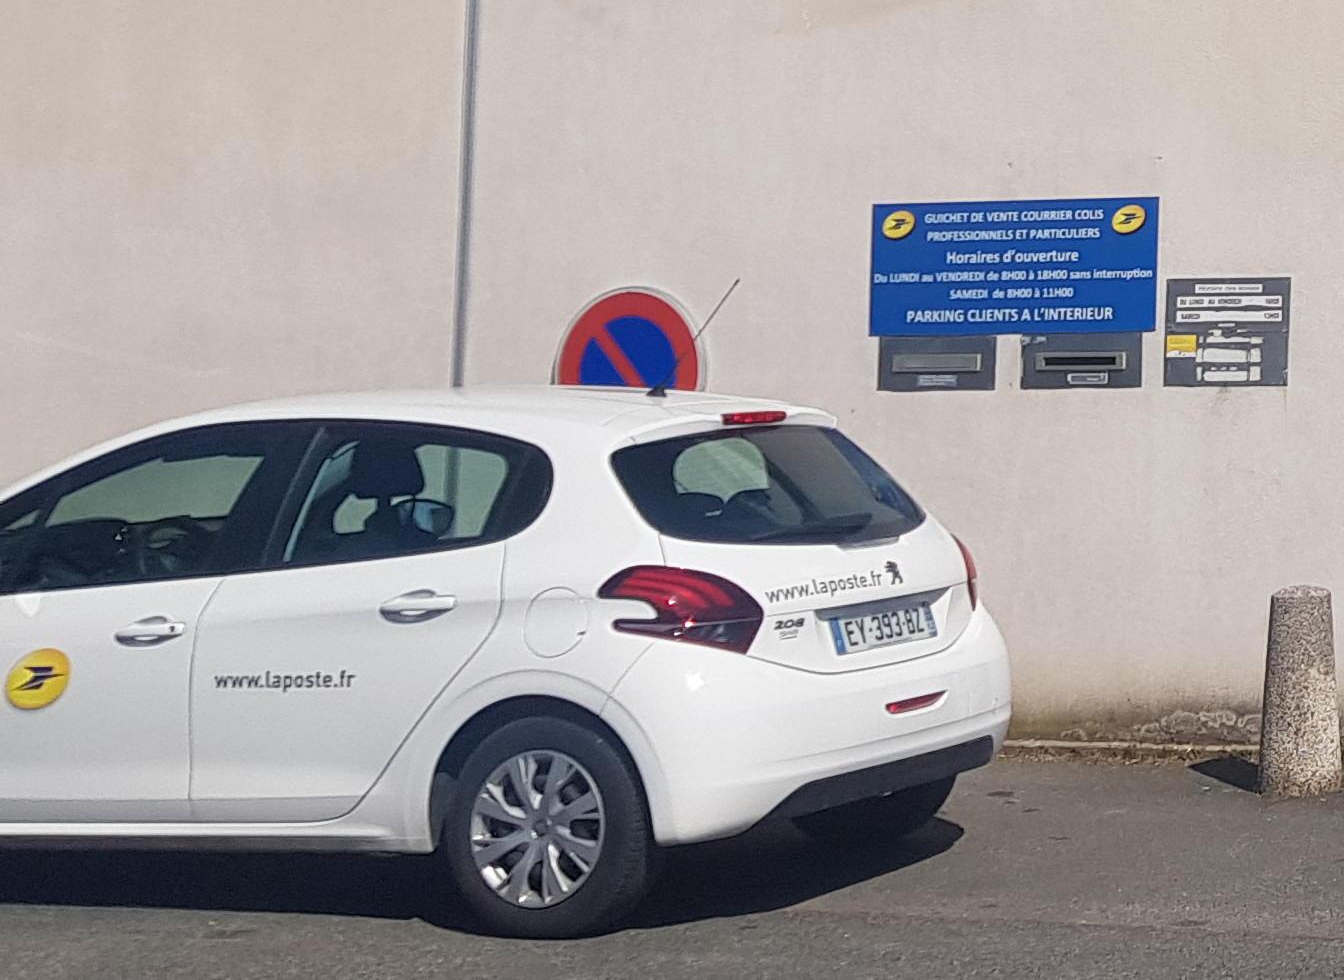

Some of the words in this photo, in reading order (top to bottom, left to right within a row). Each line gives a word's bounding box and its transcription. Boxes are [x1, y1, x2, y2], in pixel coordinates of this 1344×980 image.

[924, 211, 969, 224] GUICHET
[970, 211, 984, 223] DE
[986, 211, 1019, 222] VENTE
[1021, 210, 1073, 221] COURRIER
[1075, 208, 1104, 220] COLIS
[927, 229, 1013, 242] PROFESSIONNELS
[1016, 229, 1028, 240] ET
[1029, 228, 1100, 239] PARTICULIERS
[946, 250, 1000, 264] Horaires
[1002, 249, 1079, 263] d'ouverture
[874, 273, 887, 283] Du
[889, 272, 919, 282] LUNDI
[921, 273, 934, 282] au
[935, 271, 985, 282] VENDREDI
[986, 271, 1000, 281] de
[1001, 270, 1026, 280] 8H00
[1028, 270, 1034, 280] à
[1037, 269, 1068, 280] 18H00
[1070, 271, 1091, 279] sans
[1093, 268, 1153, 280] interruption
[949, 289, 988, 300] SAMEDI
[992, 289, 1004, 298] de
[1007, 288, 1032, 298] 8H00
[1034, 288, 1041, 298] à
[1042, 287, 1074, 298] 11H00
[906, 309, 965, 323] PARKING
[967, 308, 1018, 322] CLIENTS
[1020, 308, 1031, 321] A
[1034, 306, 1113, 321] L'INTERIEUR
[765, 570, 882, 603] www.laposte.fr
[774, 618, 805, 630] 208
[214, 670, 356, 693] www.laposte.fr
